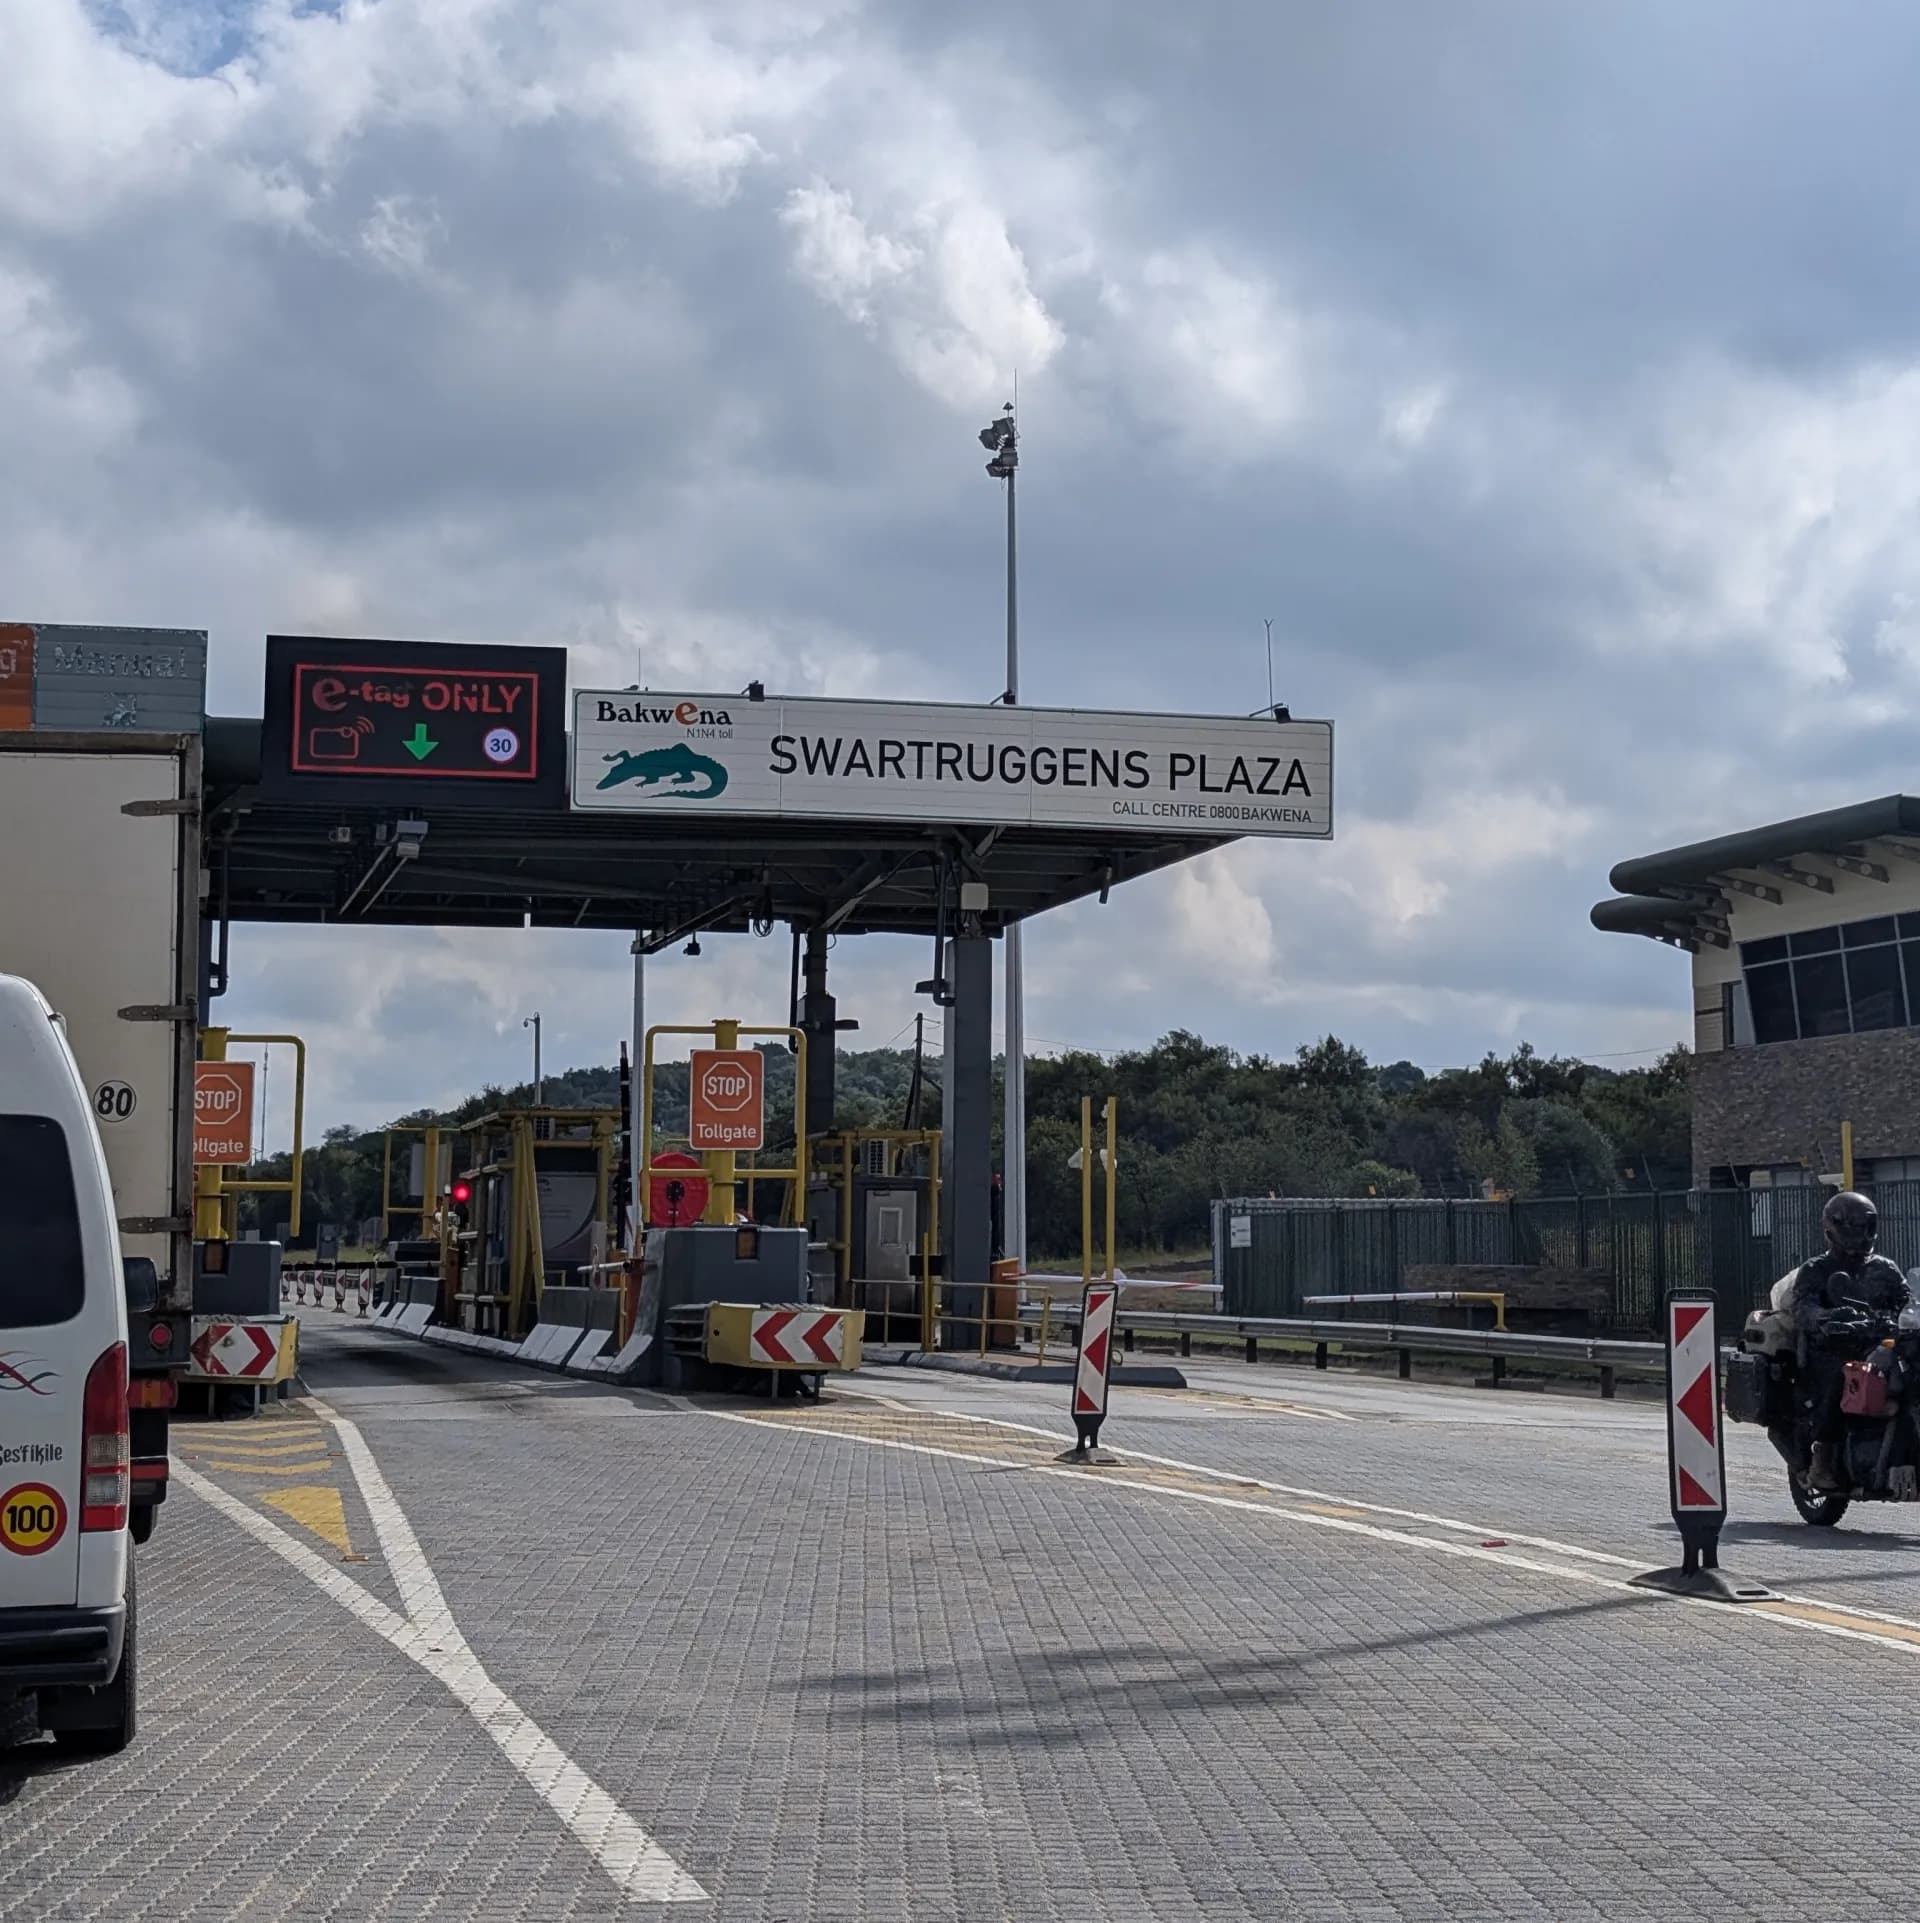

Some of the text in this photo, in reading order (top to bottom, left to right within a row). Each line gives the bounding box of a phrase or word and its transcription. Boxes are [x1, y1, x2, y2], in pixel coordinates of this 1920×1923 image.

[55, 642, 189, 678] Manual
[421, 681, 521, 713] ONLY
[597, 700, 732, 726] Bakwena
[686, 728, 733, 739] N1N4 toll
[490, 738, 512, 753] 30
[769, 735, 1312, 797] SWARTRUGGENS PLAZA
[1113, 801, 1149, 816] CALL
[1152, 803, 1206, 818] CENTRE
[707, 1076, 746, 1096] STOP
[98, 1086, 133, 1117] 80
[194, 1090, 236, 1109] STOP
[696, 1123, 757, 1142] Tollgate
[6, 1505, 55, 1533] 100
